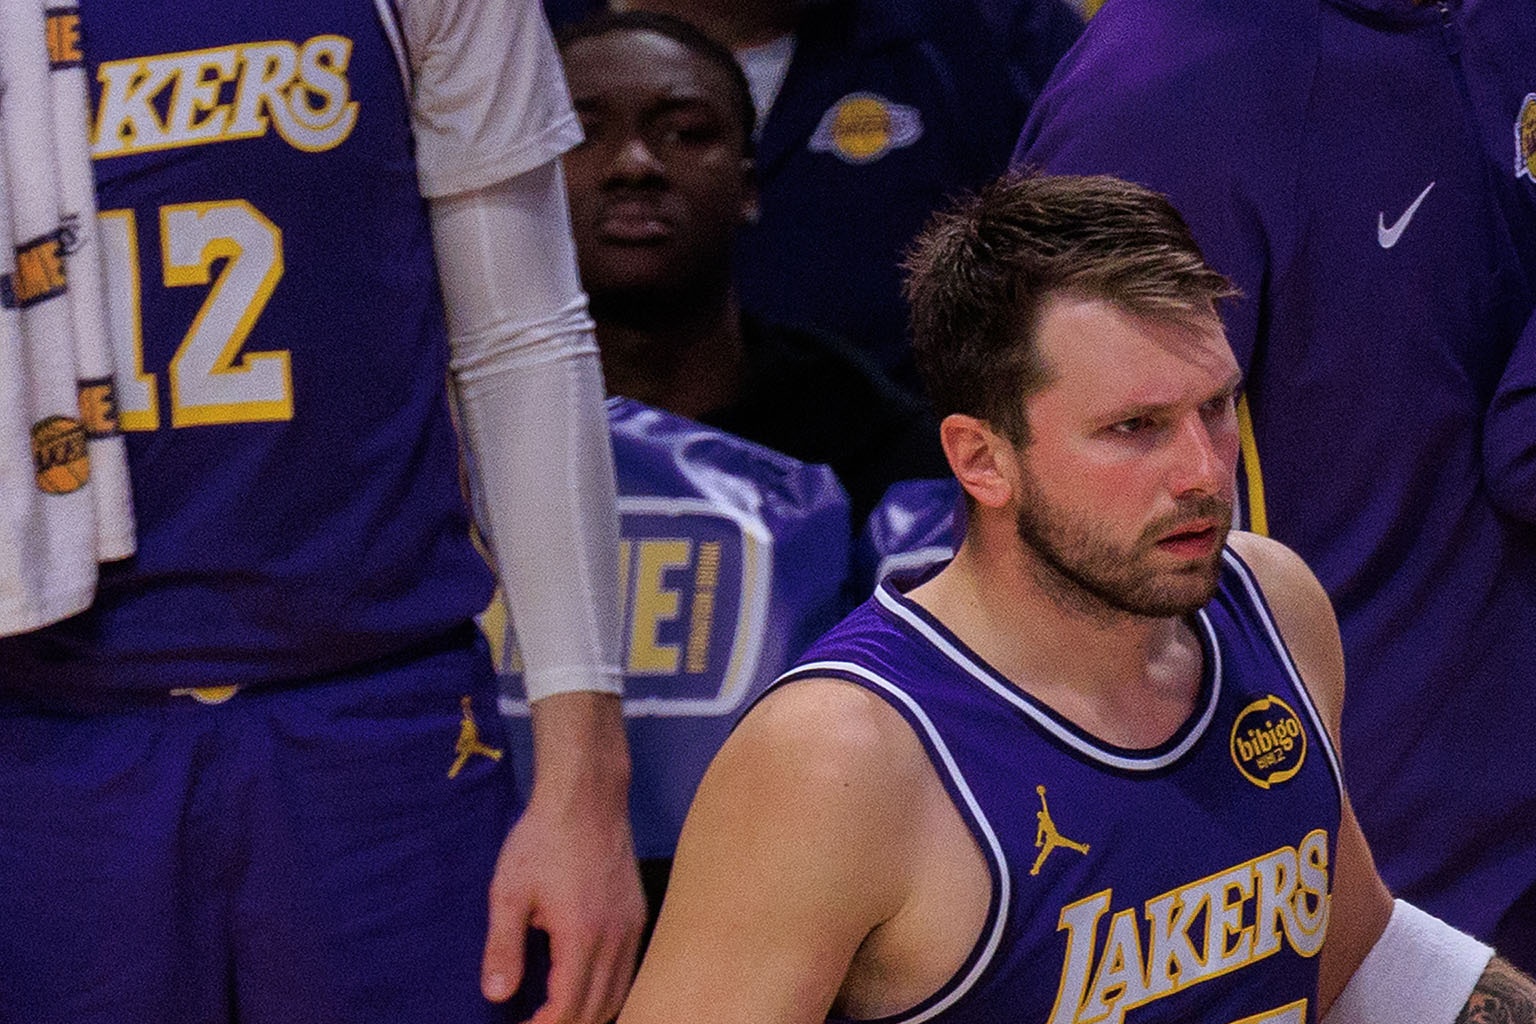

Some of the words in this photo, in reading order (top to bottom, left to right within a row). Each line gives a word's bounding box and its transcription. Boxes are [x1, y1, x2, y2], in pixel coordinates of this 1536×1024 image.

[90, 34, 360, 160] KERS
[97, 199, 294, 433] 12
[1236, 718, 1300, 762] bibigo
